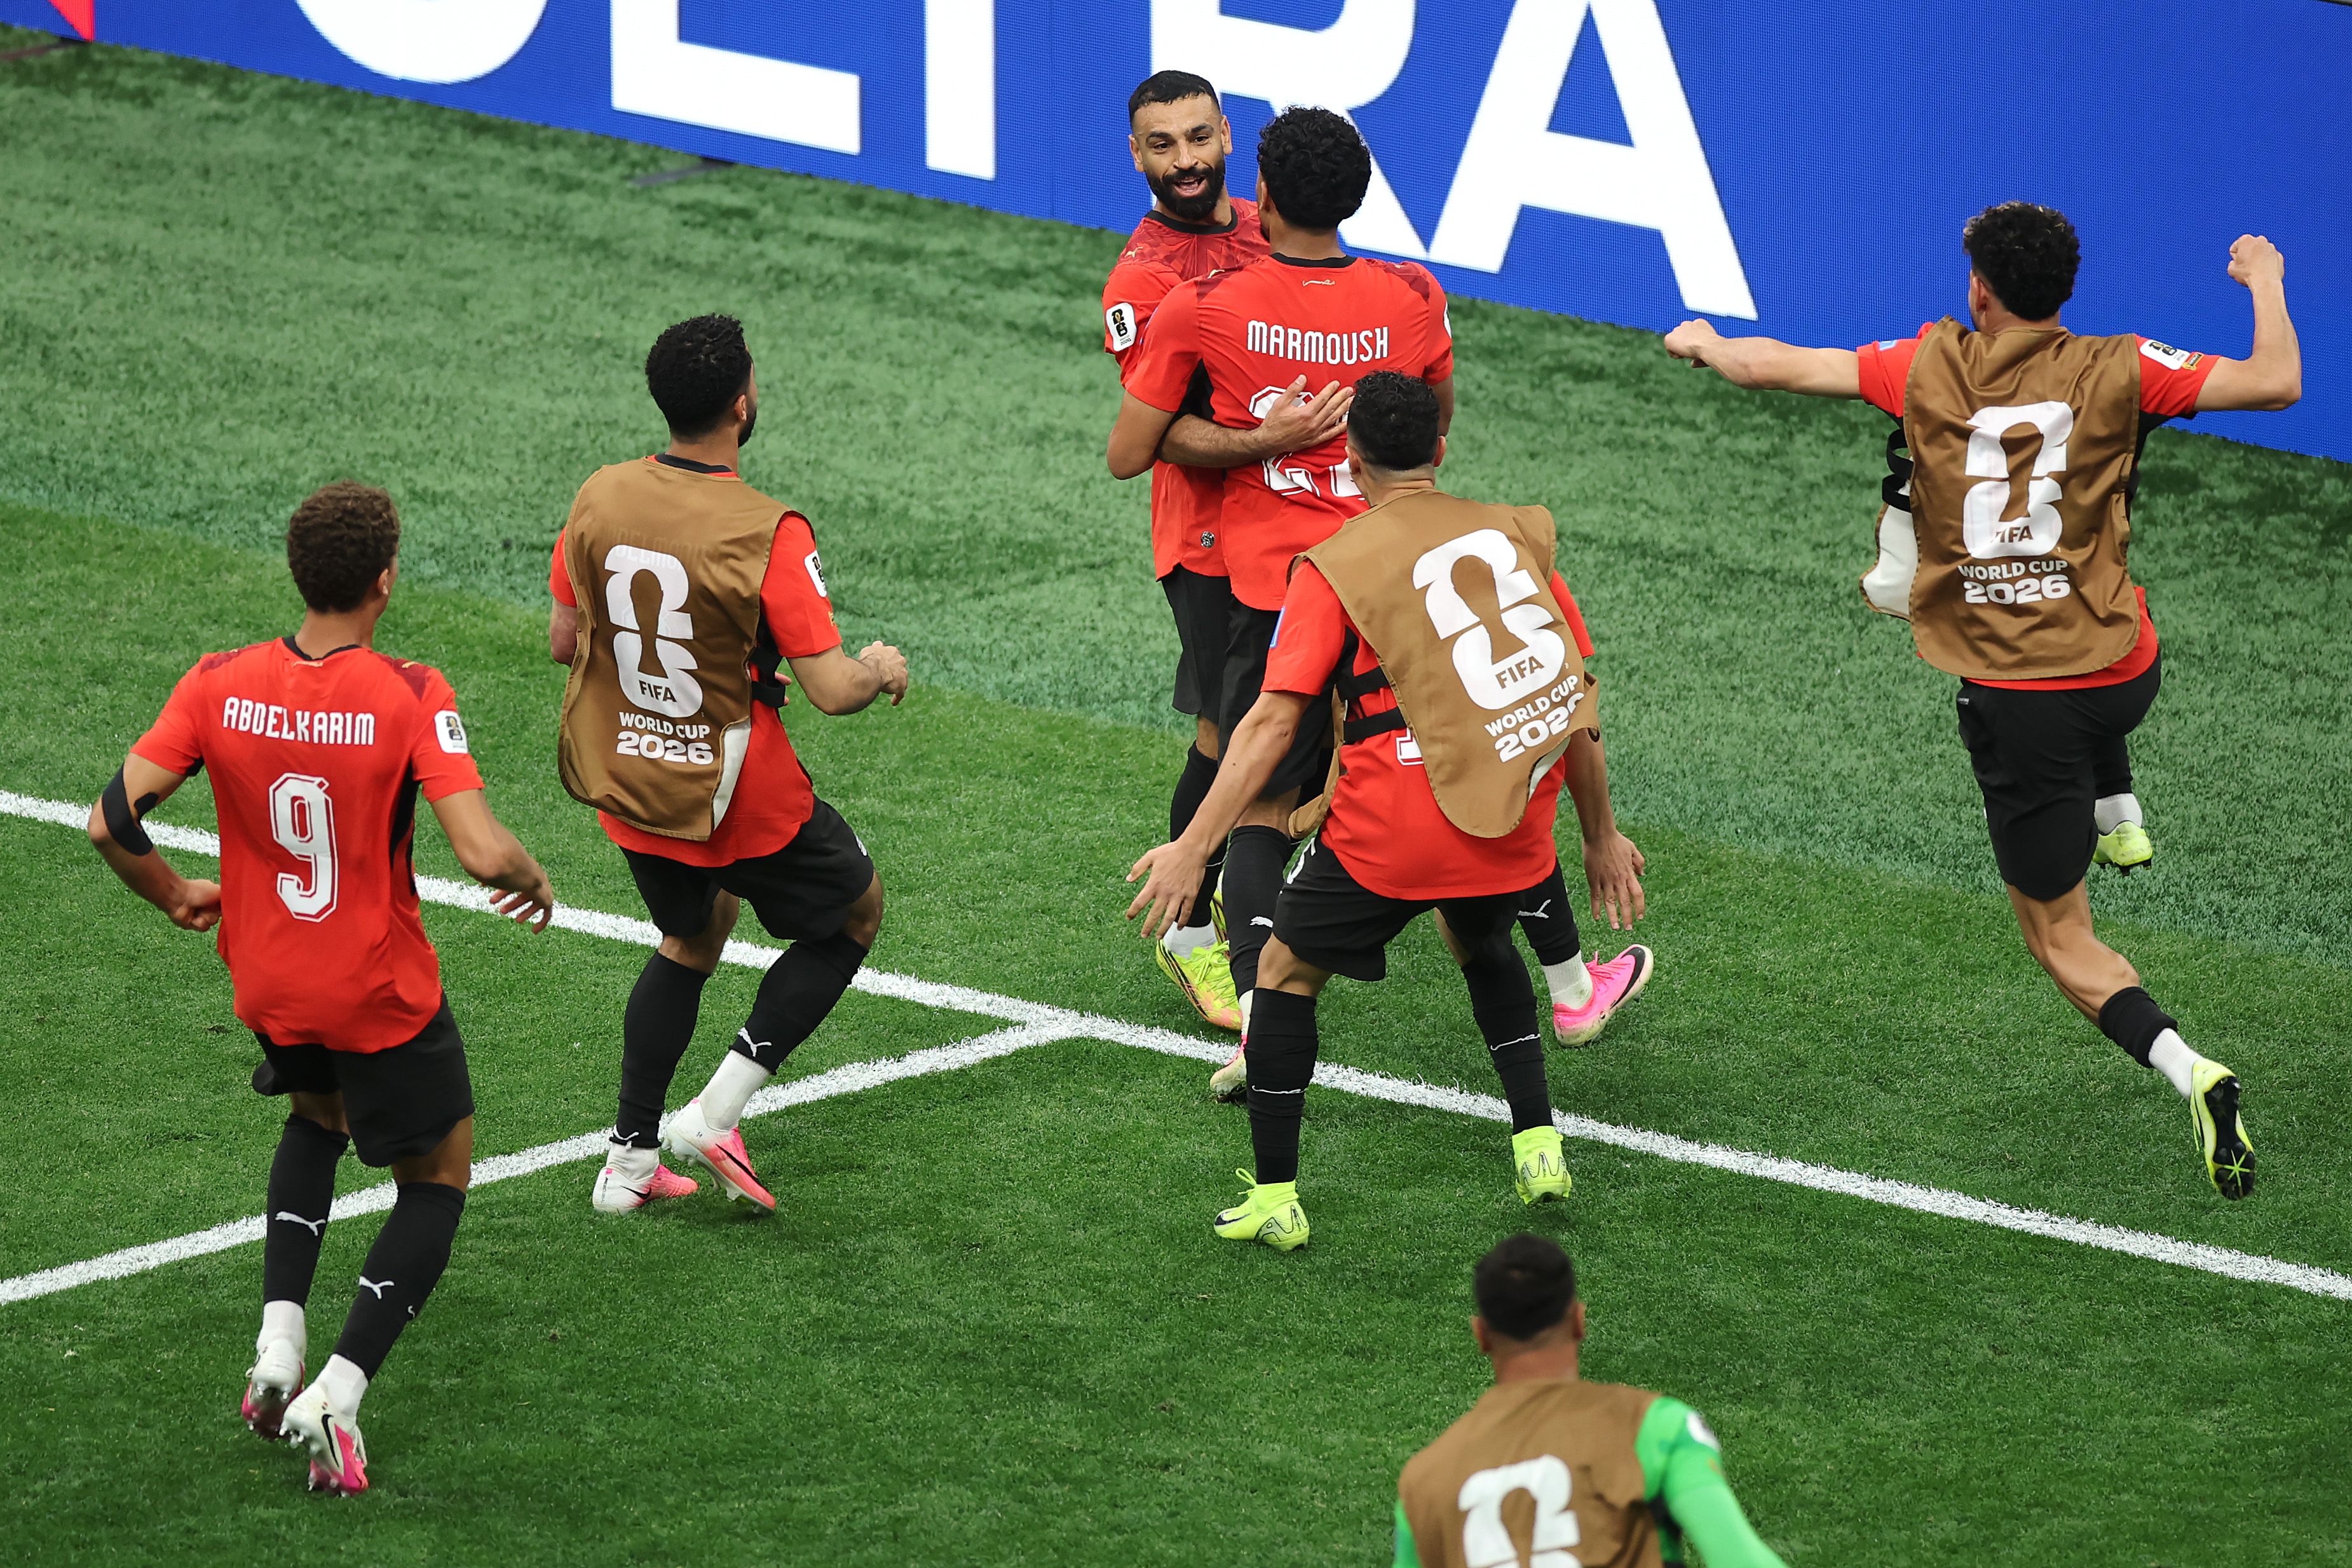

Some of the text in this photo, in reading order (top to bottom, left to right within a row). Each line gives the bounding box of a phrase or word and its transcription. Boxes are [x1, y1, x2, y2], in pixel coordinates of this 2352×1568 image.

[1247, 320, 1389, 365] MARMOUSH
[1990, 525, 2034, 543] IFA
[1958, 560, 2068, 581] WORLD CUP
[1963, 574, 2070, 604] 2026
[1495, 656, 1545, 689] FIFA
[639, 680, 677, 702] FIFA
[1485, 675, 1579, 737] WORLD CUP
[222, 696, 375, 745] ABDELKARIM
[619, 712, 710, 739] WORLD CUP
[616, 731, 714, 765] 2026
[269, 772, 338, 923] 9
